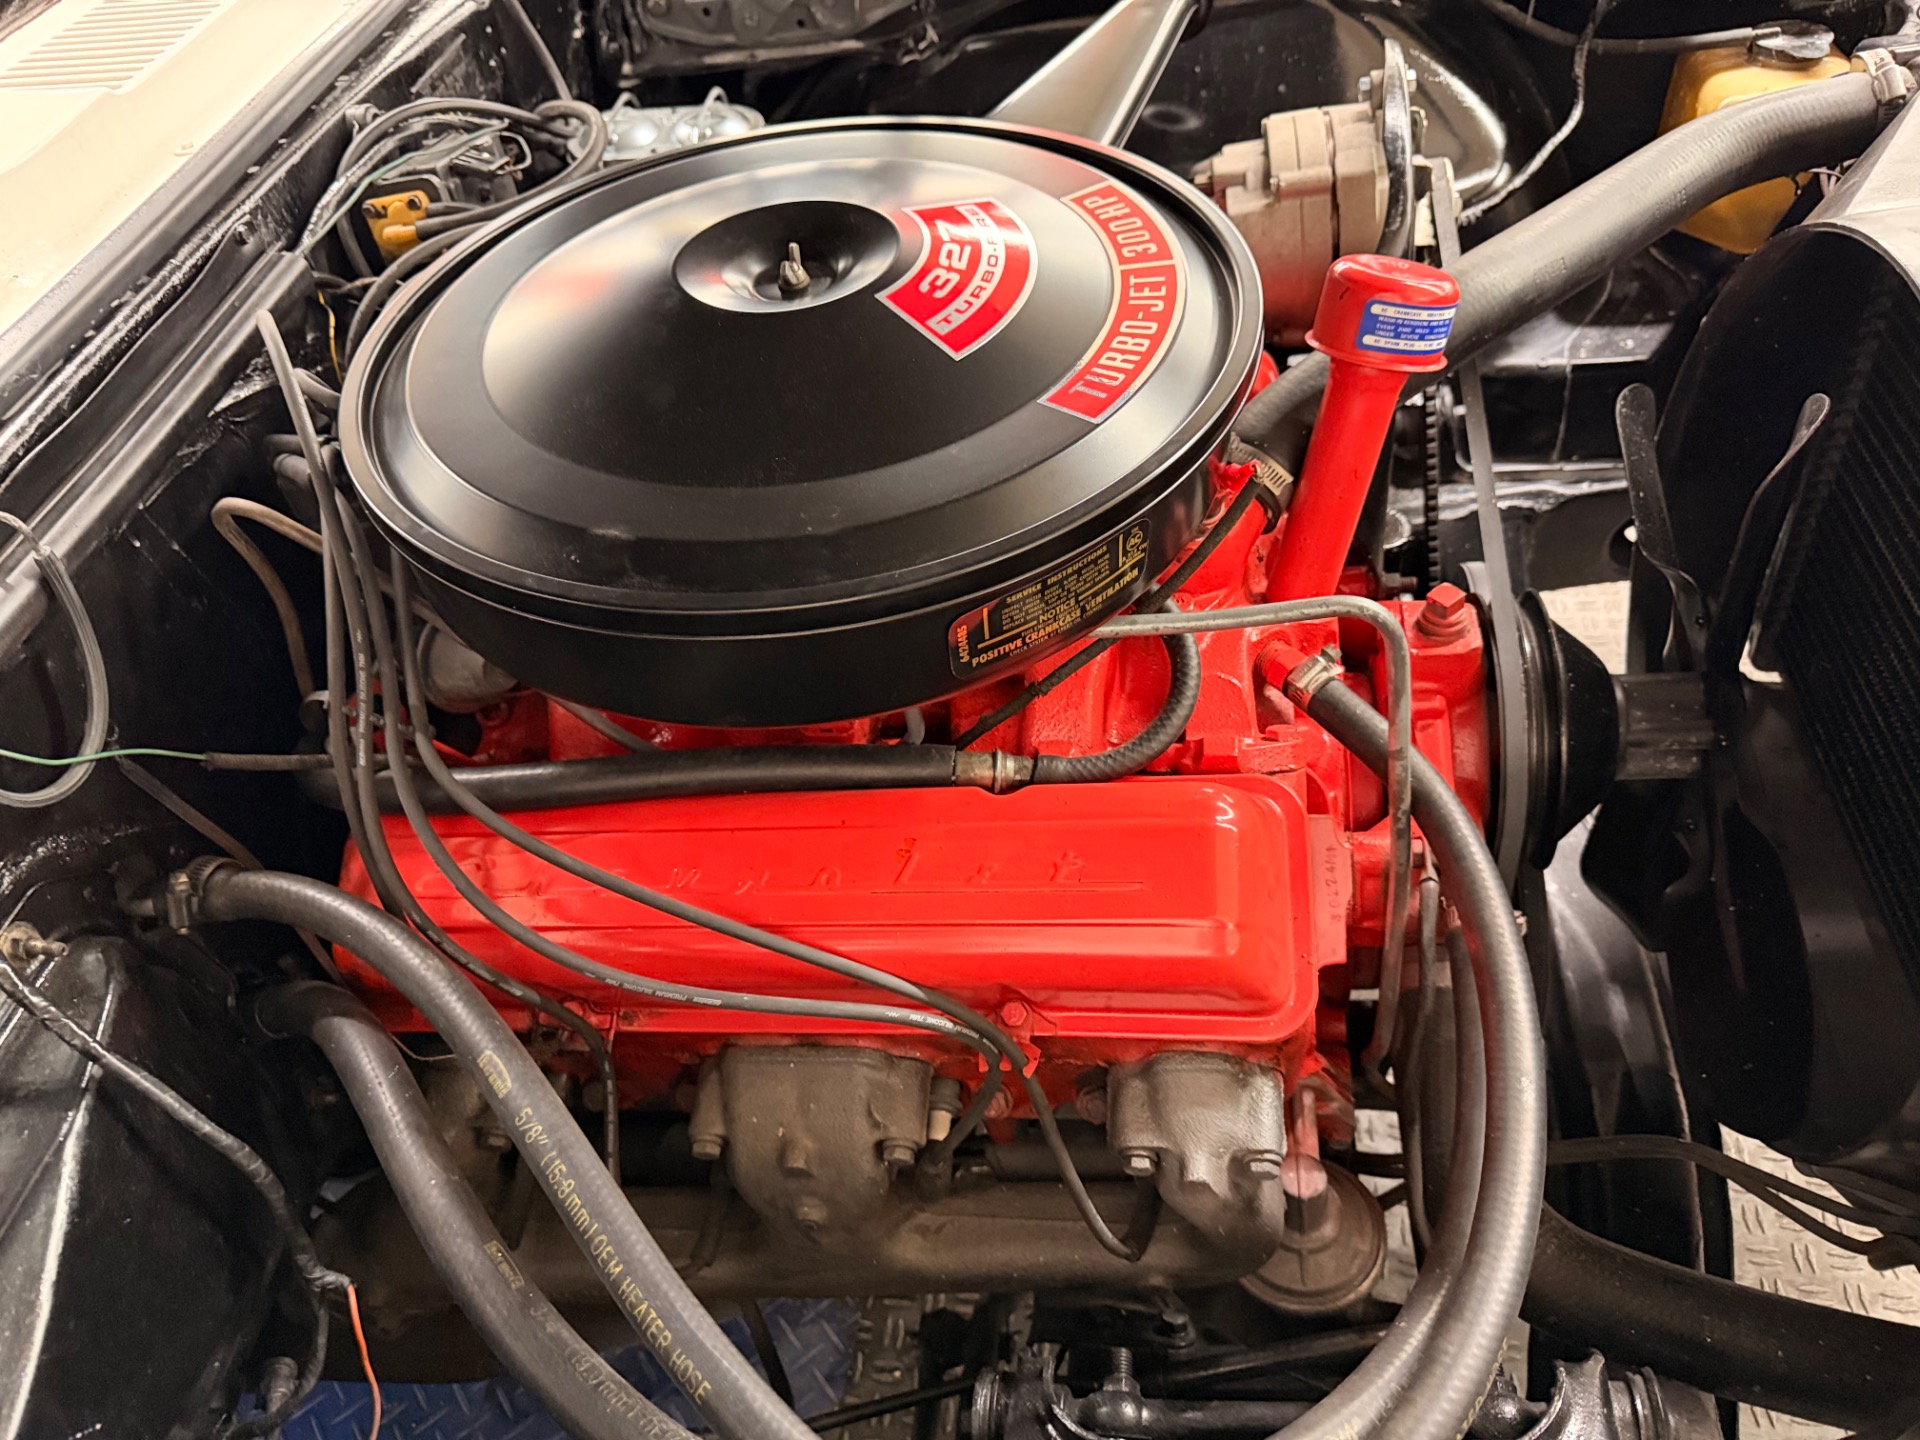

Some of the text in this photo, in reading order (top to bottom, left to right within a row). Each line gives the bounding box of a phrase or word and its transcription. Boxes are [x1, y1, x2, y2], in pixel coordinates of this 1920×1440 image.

[918, 219, 974, 299] 327
[1068, 274, 1166, 399] TURBO-JET
[1006, 545, 1107, 603] SERVICE INSTRUCTIONS
[1022, 599, 1040, 610] UNDER
[1039, 598, 1075, 623] NOTICE
[972, 568, 1138, 667] POSITIVE CRANKCASE VENTILATION
[1013, 612, 1024, 620] NOT
[1003, 618, 1023, 630] REPLACE
[957, 624, 969, 664] 6424485
[604, 978, 620, 987] 7MM
[622, 982, 653, 995] SILICONE
[655, 990, 688, 1001] PREMIUM
[908, 1014, 924, 1022] 7MM
[926, 1016, 954, 1029] SILICONE
[590, 1234, 624, 1281] OEM
[619, 1276, 671, 1354] HEATER
[668, 1344, 712, 1405] HOSE
